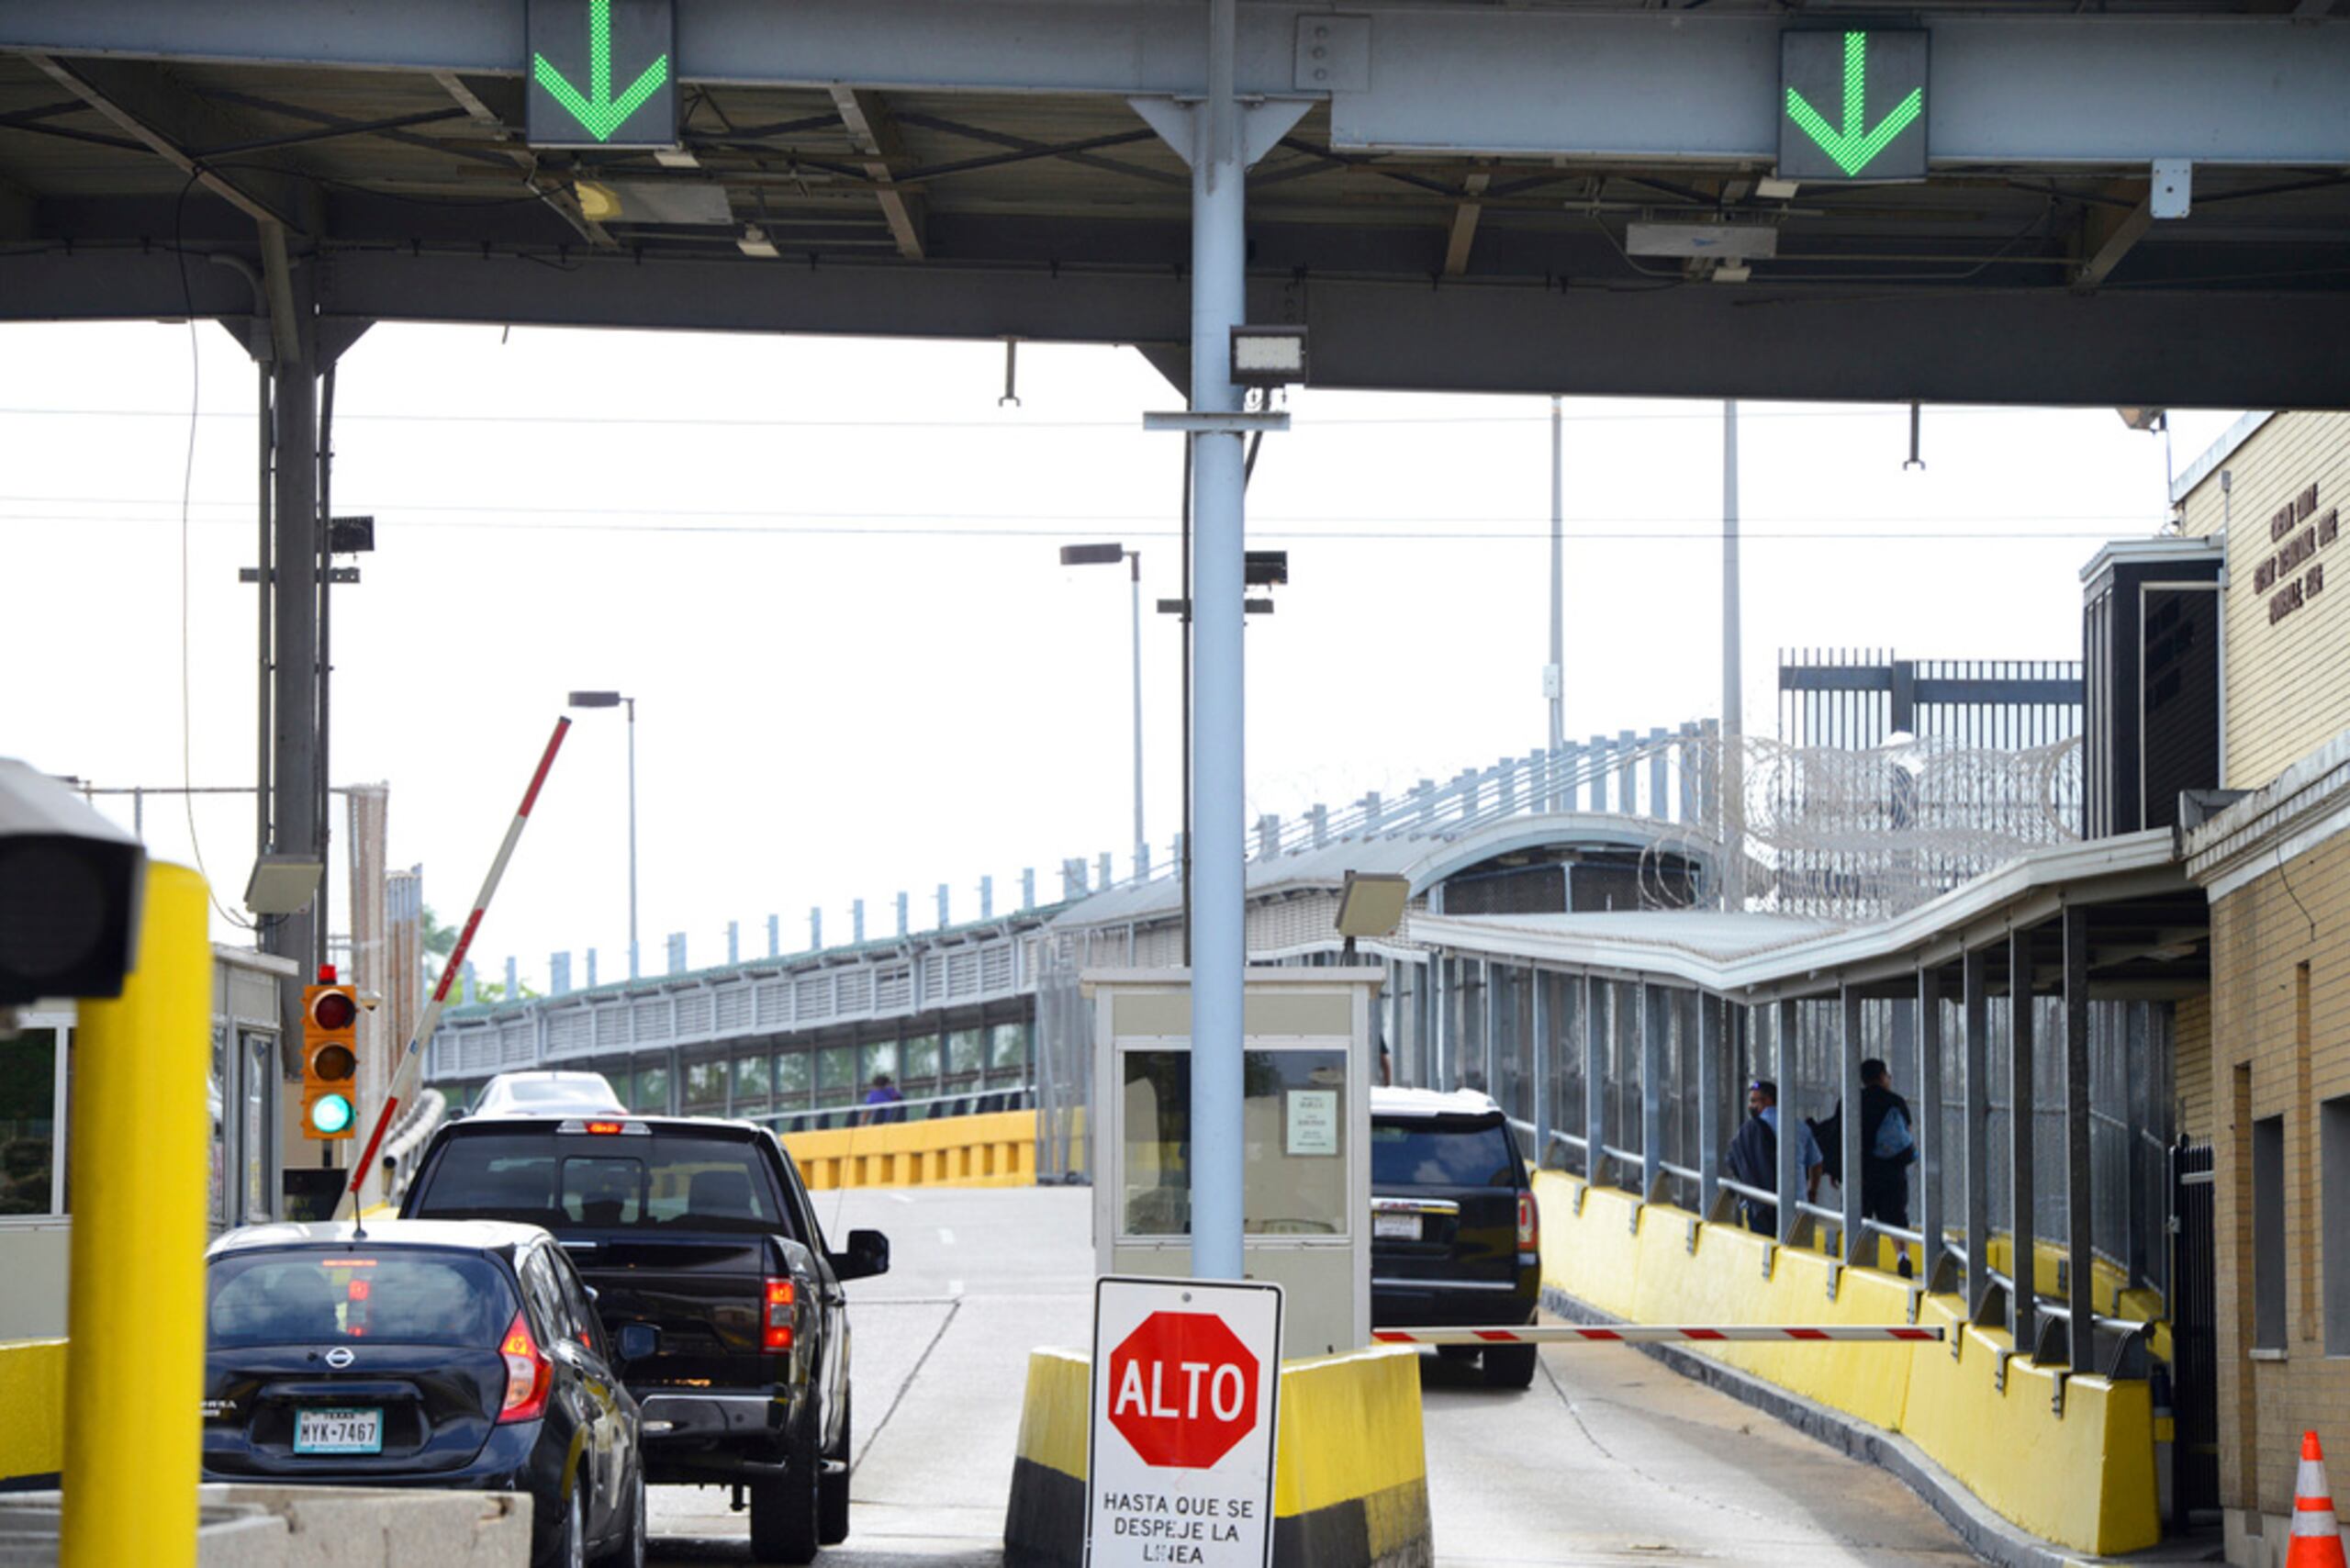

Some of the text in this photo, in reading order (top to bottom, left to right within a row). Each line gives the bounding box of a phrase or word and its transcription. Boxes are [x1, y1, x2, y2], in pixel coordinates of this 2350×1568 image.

[1114, 1359, 1245, 1422] ALTO
[1103, 1492, 1253, 1518] HASTA QUE SE
[1114, 1517, 1239, 1541] DESPEJE LA
